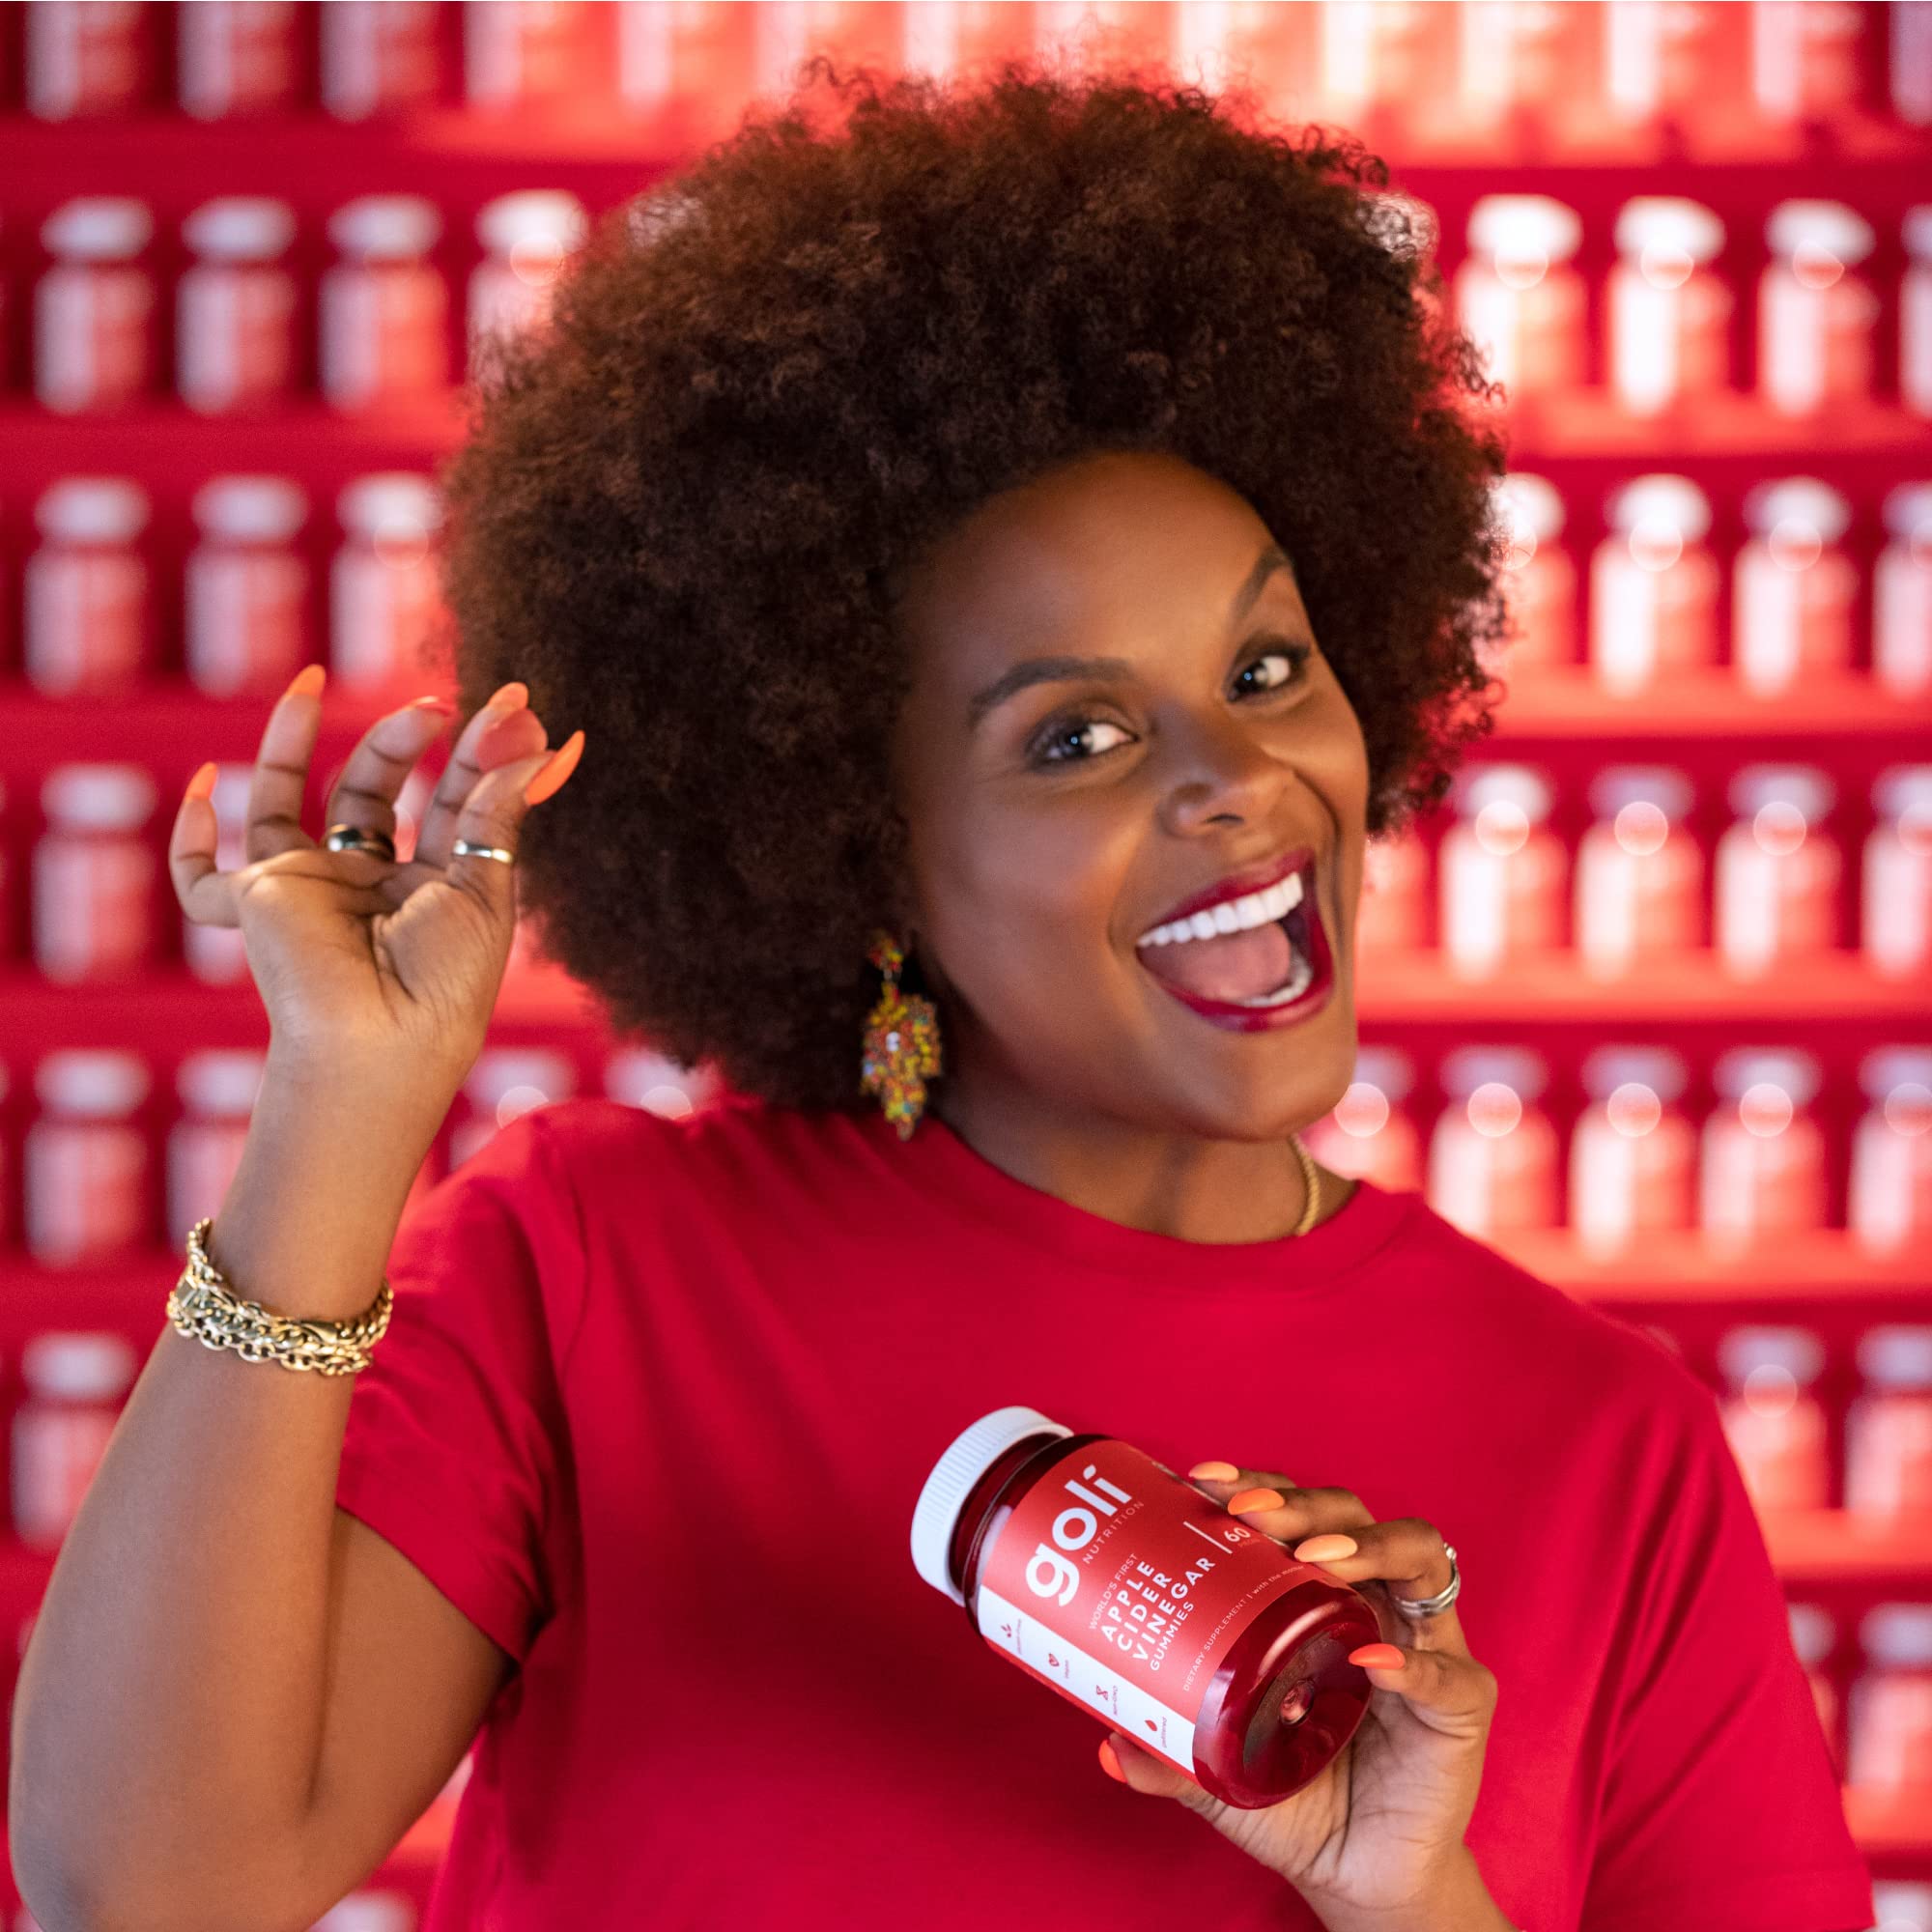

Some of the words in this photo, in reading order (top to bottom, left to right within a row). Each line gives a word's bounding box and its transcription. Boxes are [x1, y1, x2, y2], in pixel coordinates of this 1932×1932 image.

[1026, 1464, 1133, 1606] goli
[1082, 1501, 1145, 1565] NUTRITION
[1223, 1527, 1251, 1543] 60
[1089, 1581, 1118, 1631] WORLD'S
[1114, 1553, 1138, 1577] FIRST
[1101, 1561, 1154, 1642] APPLE
[1117, 1573, 1173, 1651] CIDER
[1132, 1557, 1216, 1661] VINEGAR
[1150, 1601, 1194, 1671] GUMMIES
[1183, 1652, 1206, 1692] DIETARY
[1204, 1599, 1247, 1651] SUPPLEMENT
[1252, 1581, 1268, 1594] with
